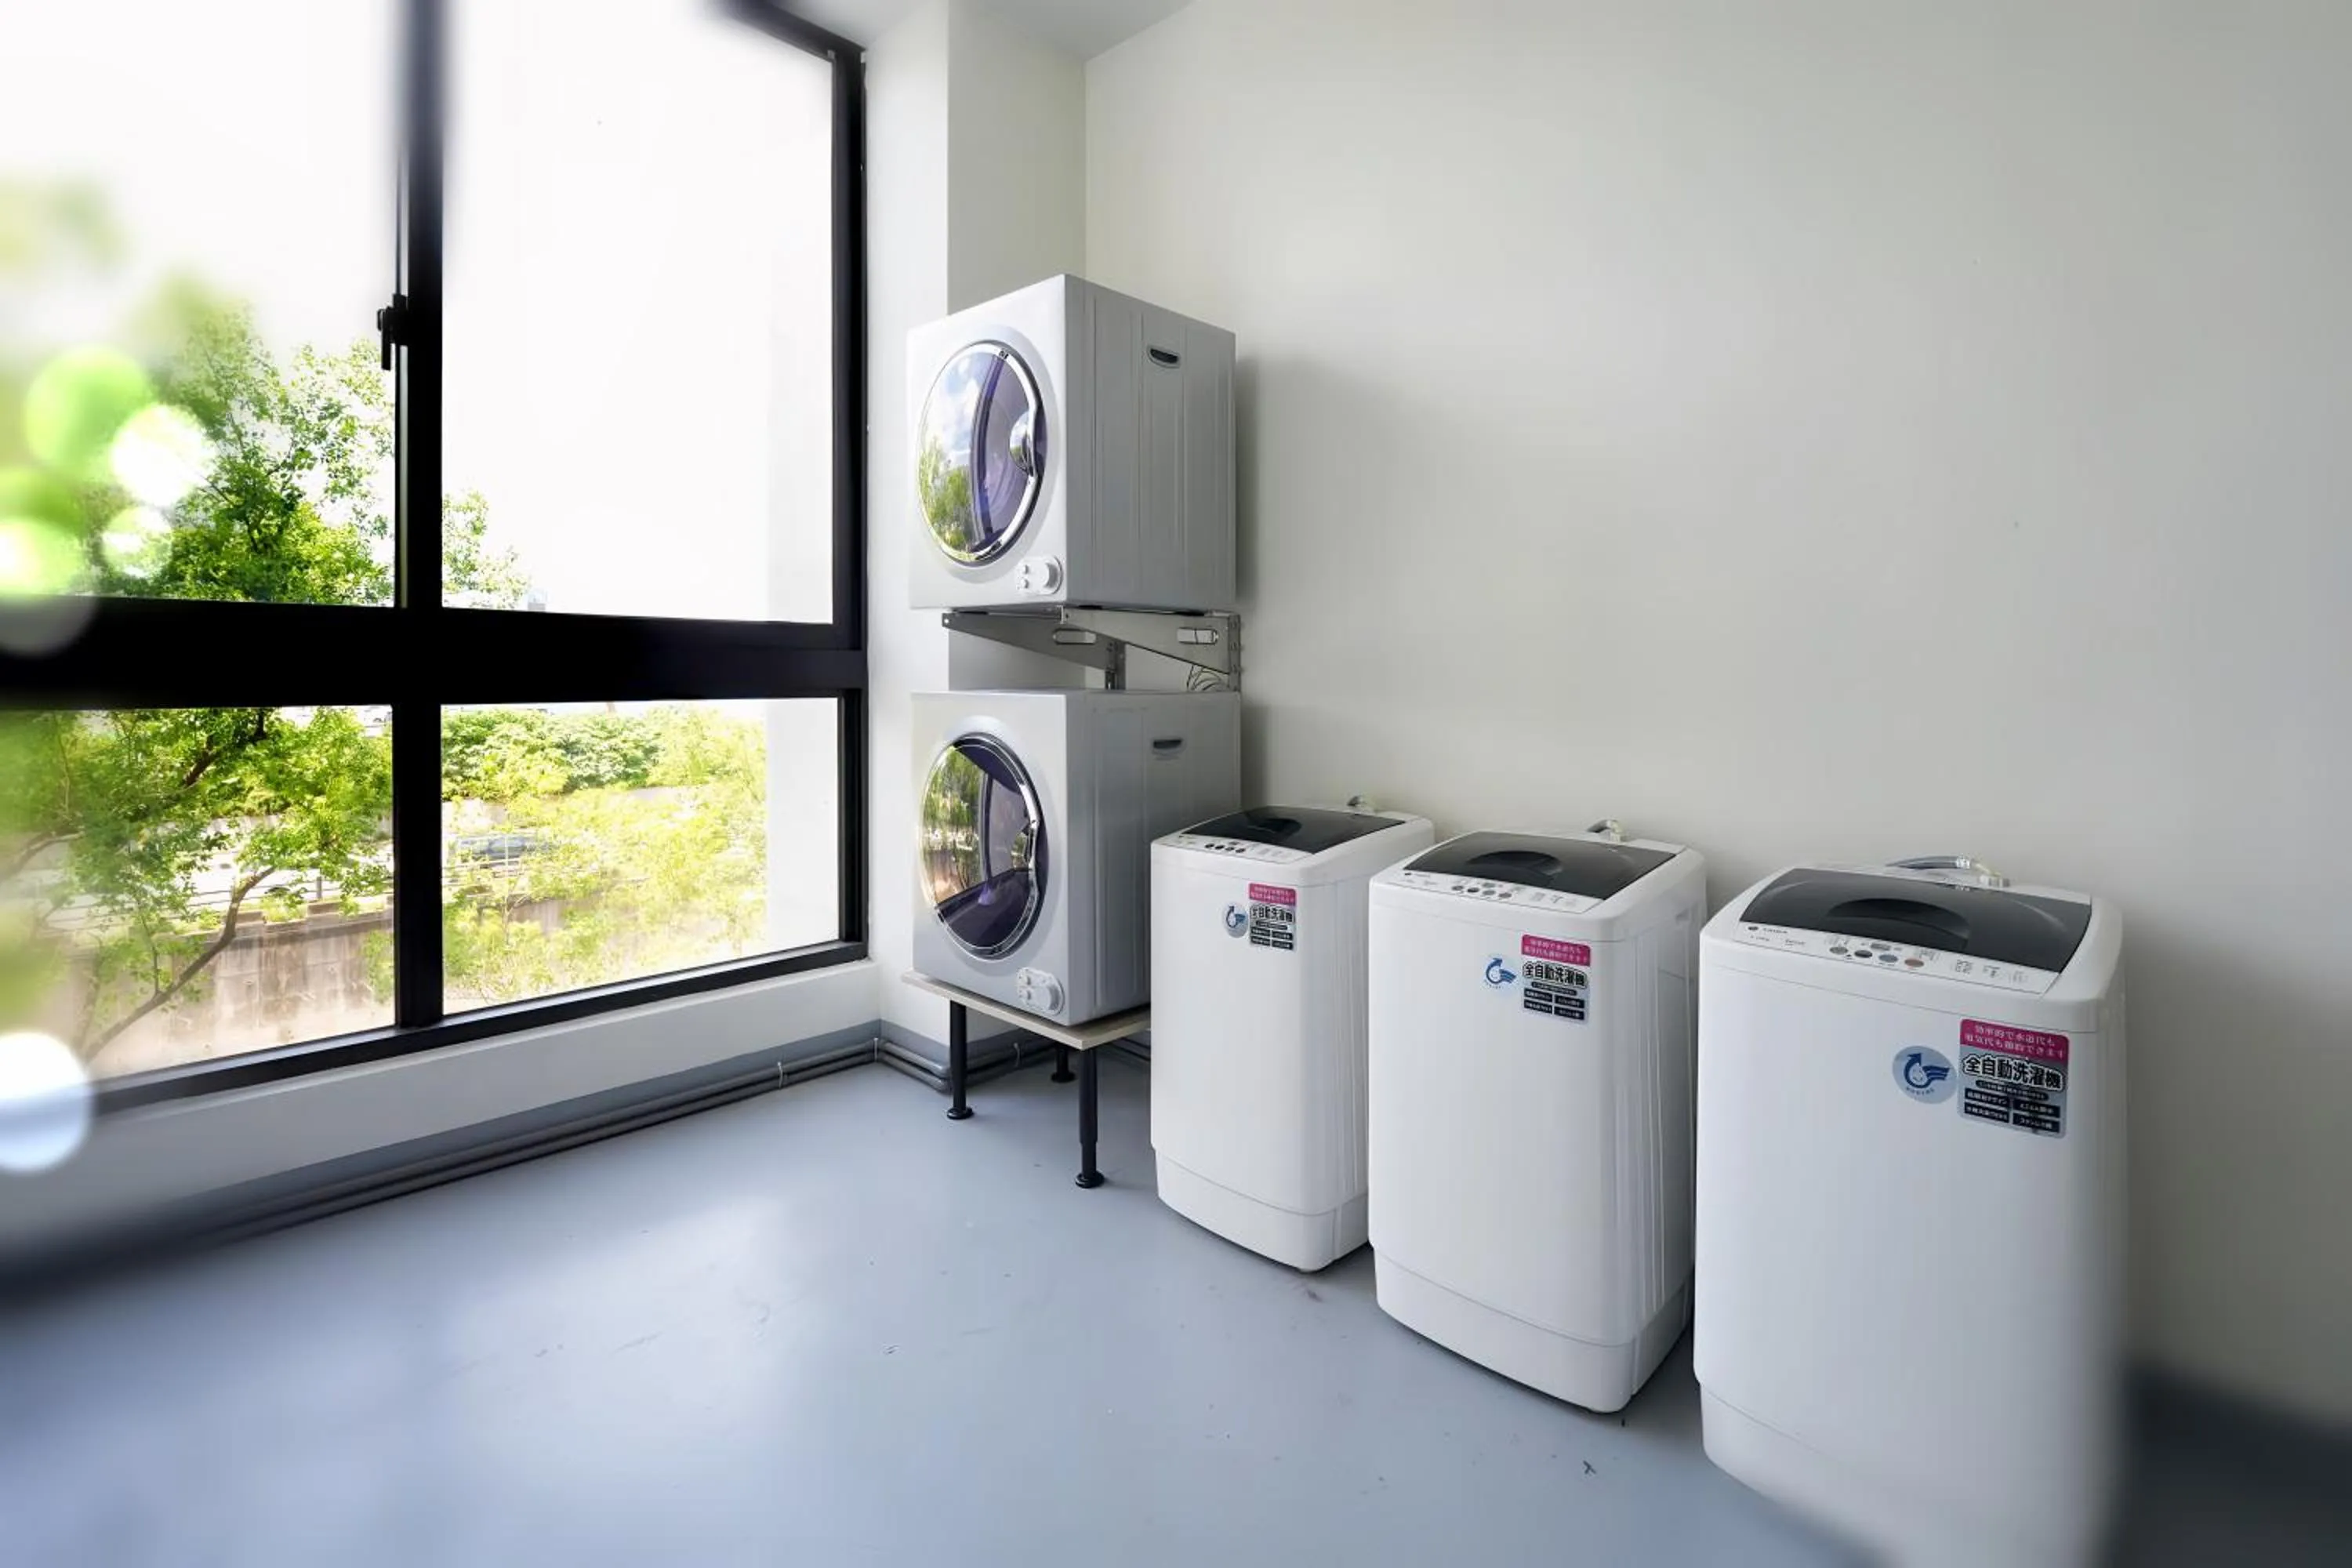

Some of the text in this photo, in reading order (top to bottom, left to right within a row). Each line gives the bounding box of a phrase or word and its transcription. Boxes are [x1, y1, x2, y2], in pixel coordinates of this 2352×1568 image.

[1965, 1056, 2063, 1090] 全自動洗濯機
